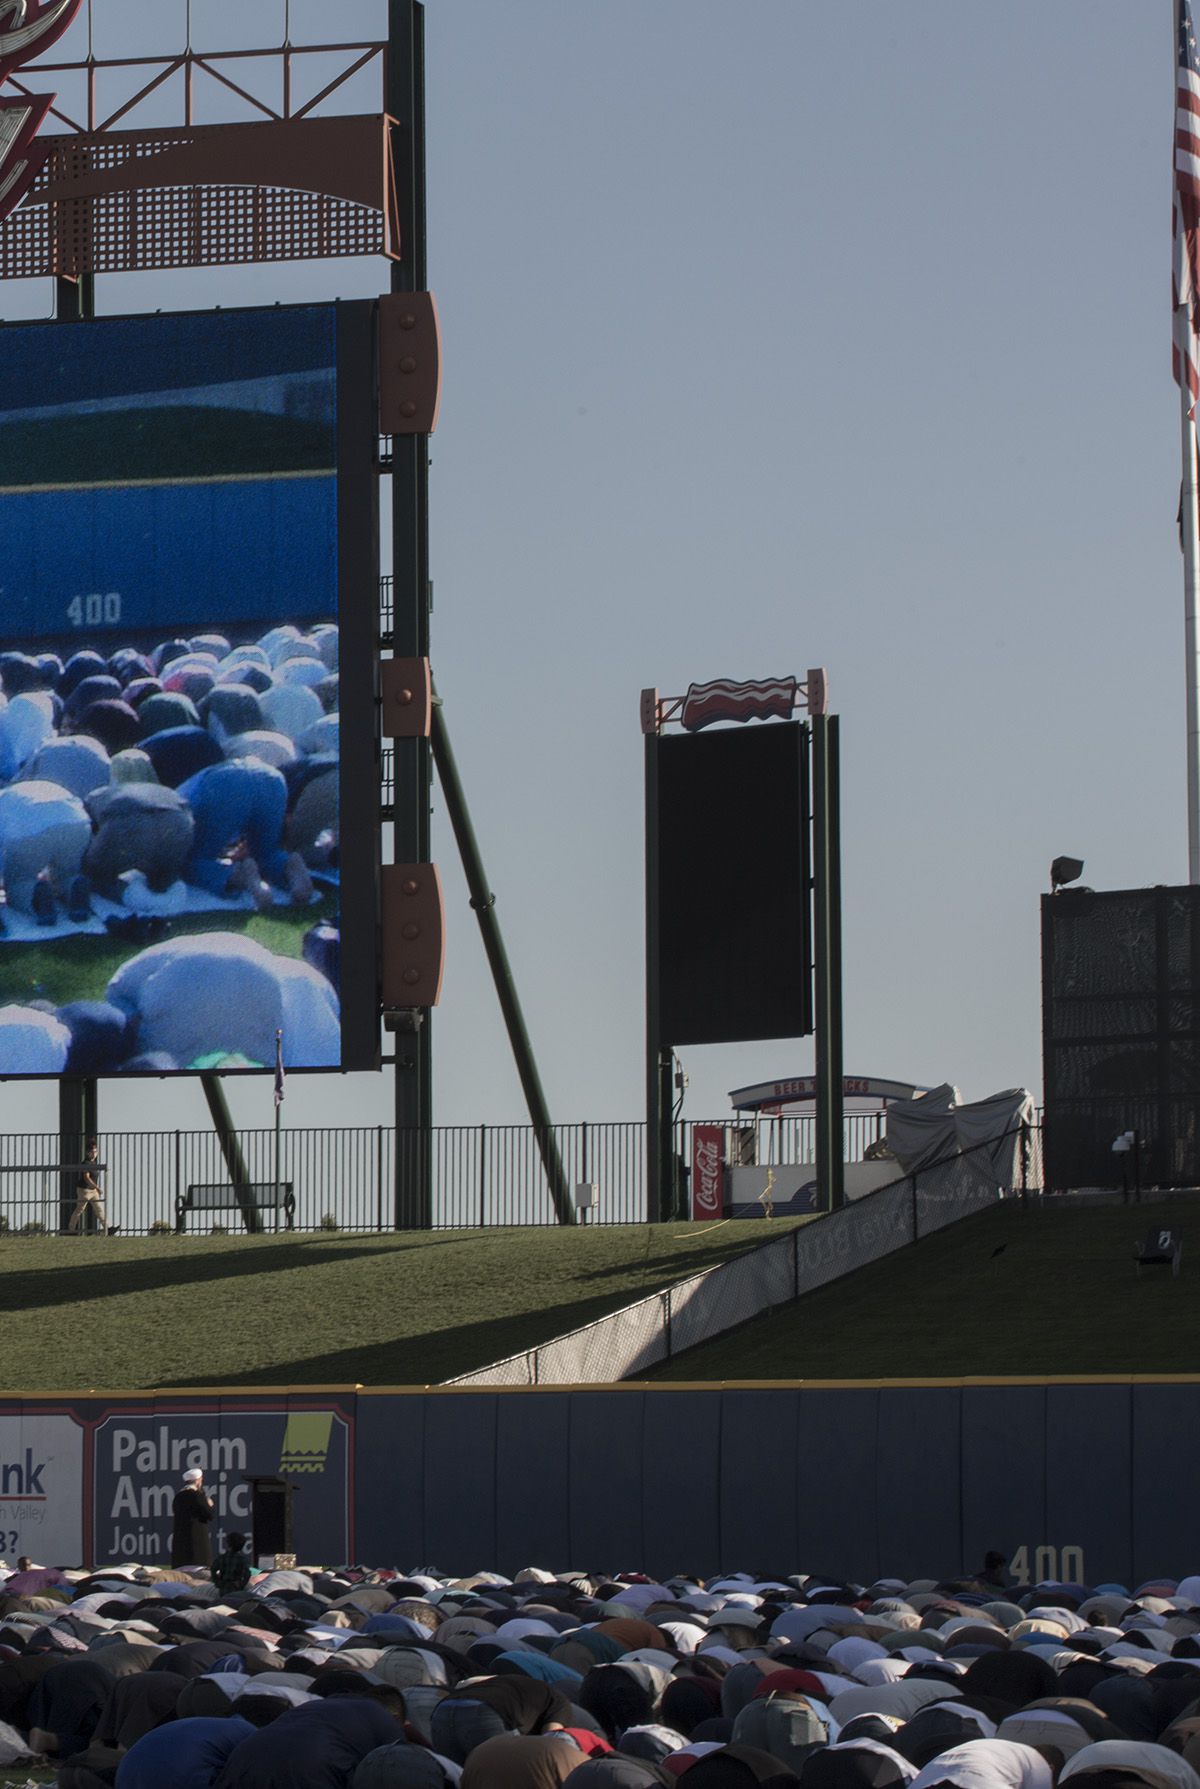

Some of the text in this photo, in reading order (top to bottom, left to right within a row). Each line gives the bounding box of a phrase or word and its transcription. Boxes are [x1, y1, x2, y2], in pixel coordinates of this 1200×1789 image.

[66, 592, 121, 625] 400
[112, 1426, 247, 1473] Palram
[11, 1504, 46, 1524] Valley
[108, 1526, 161, 1555] Join
[1009, 1545, 1084, 1586] 400
